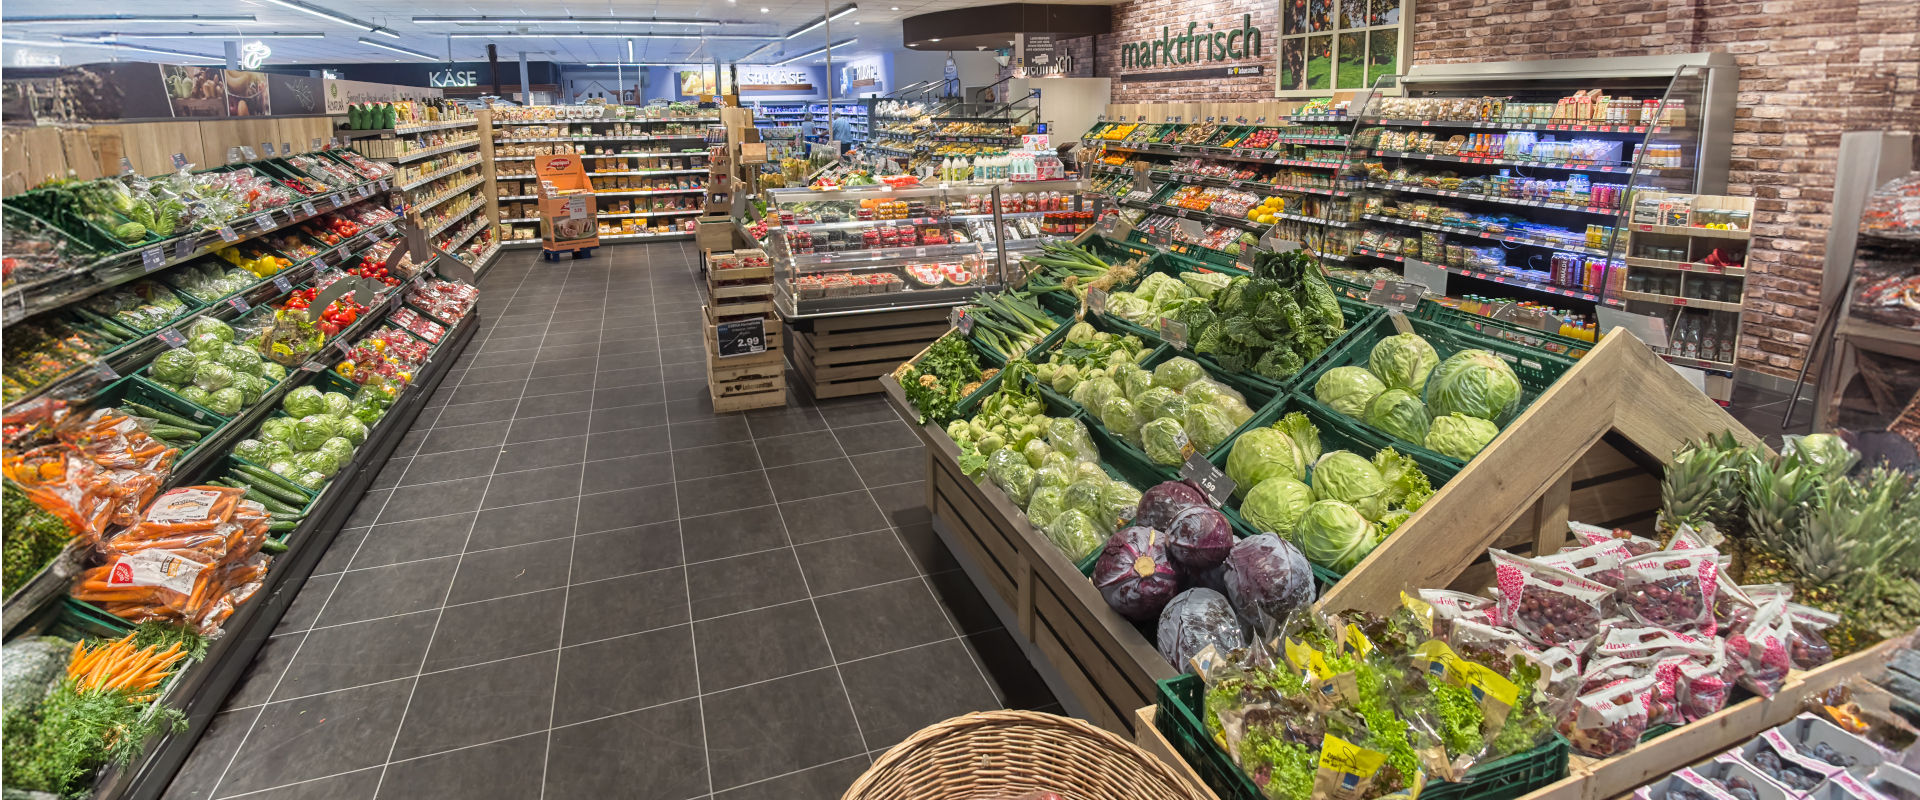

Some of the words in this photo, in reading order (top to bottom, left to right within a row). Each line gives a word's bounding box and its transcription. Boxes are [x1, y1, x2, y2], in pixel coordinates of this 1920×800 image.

[1121, 14, 1261, 68] marktfrisch
[429, 68, 477, 87] KÄSE
[737, 336, 760, 348] 2.99
[1201, 478, 1216, 492] 1.99
